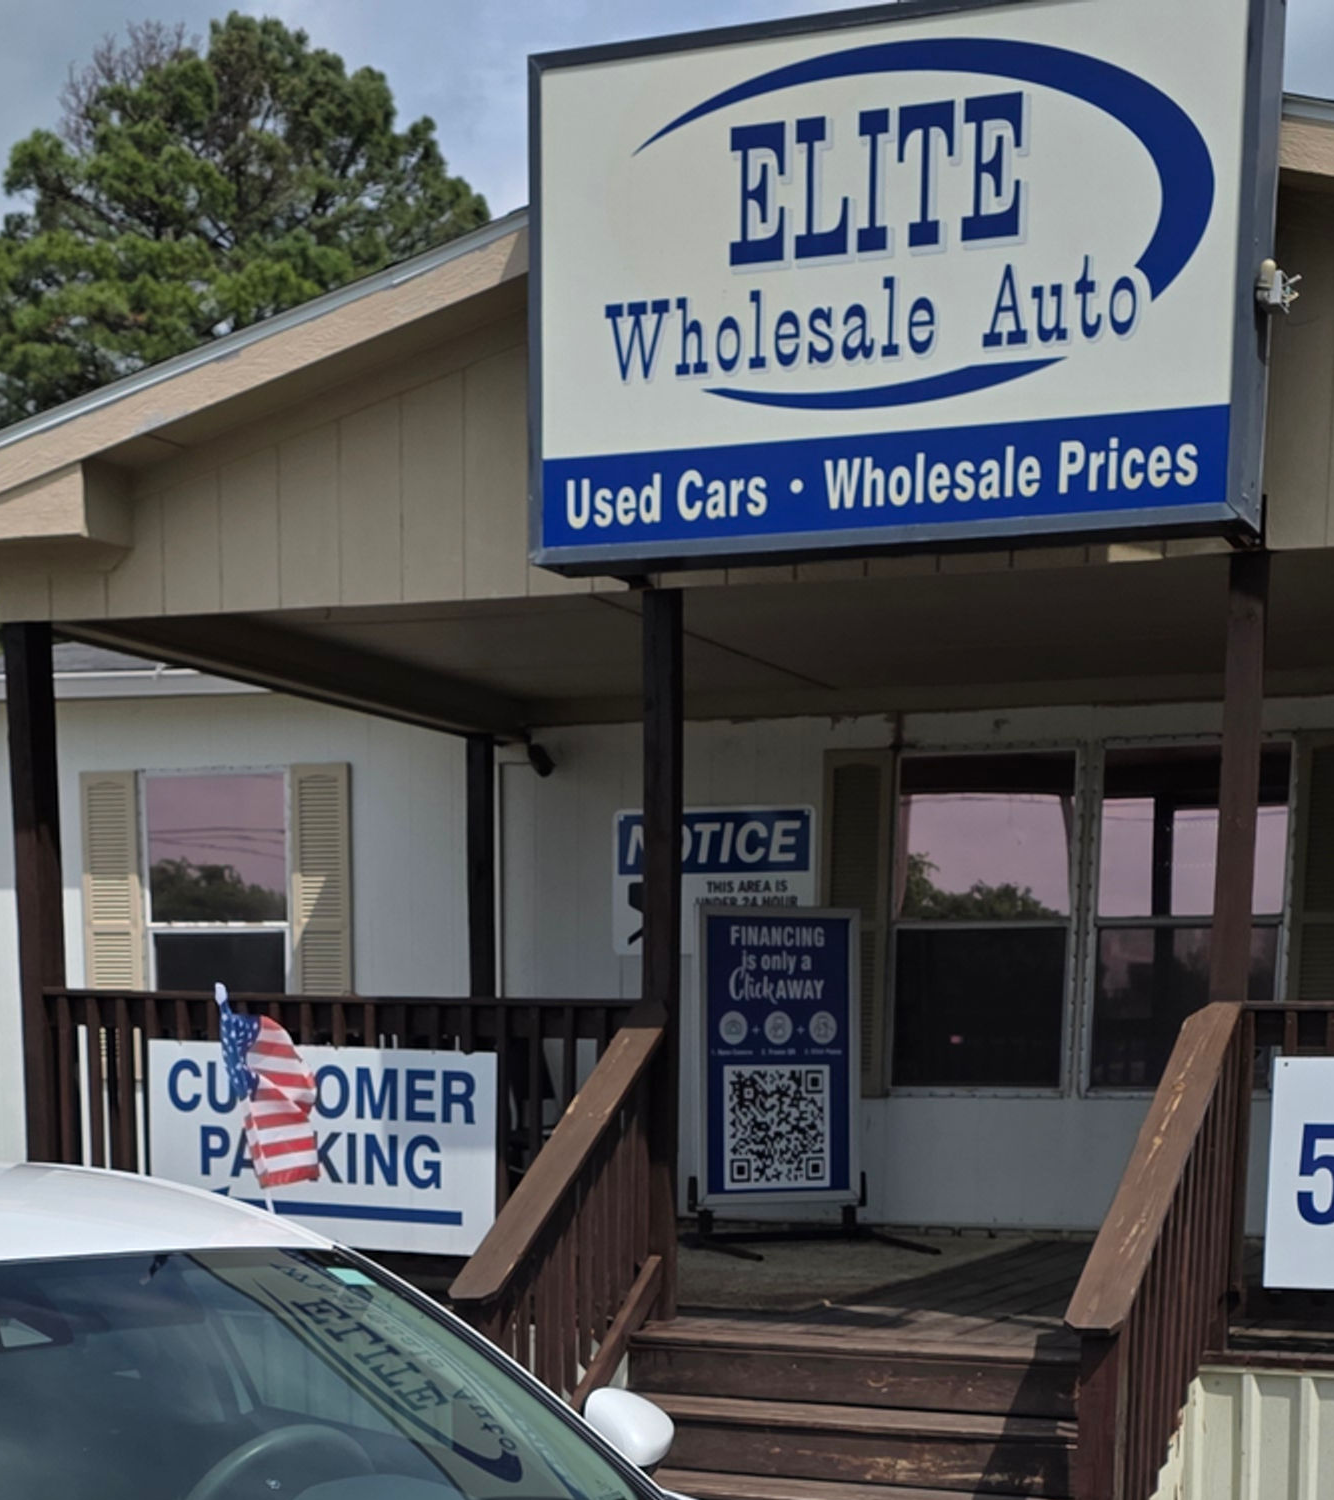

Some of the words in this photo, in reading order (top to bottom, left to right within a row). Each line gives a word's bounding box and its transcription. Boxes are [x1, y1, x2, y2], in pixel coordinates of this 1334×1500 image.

[729, 91, 1024, 266] ELITE
[605, 276, 936, 382] Wholesale
[981, 254, 1138, 349] Auto
[565, 473, 662, 530] Used
[676, 469, 768, 521] Cars
[824, 446, 1041, 510] Wholesale
[1058, 439, 1199, 494] Prices
[706, 880, 734, 893] THIS
[737, 880, 771, 893] AREA
[775, 879, 788, 892] IS
[729, 925, 826, 948] FINANCING
[741, 950, 757, 972] is
[760, 950, 798, 976] only
[800, 953, 813, 972] a
[167, 1058, 477, 1125] CUOMER
[199, 1124, 443, 1189] PAKING
